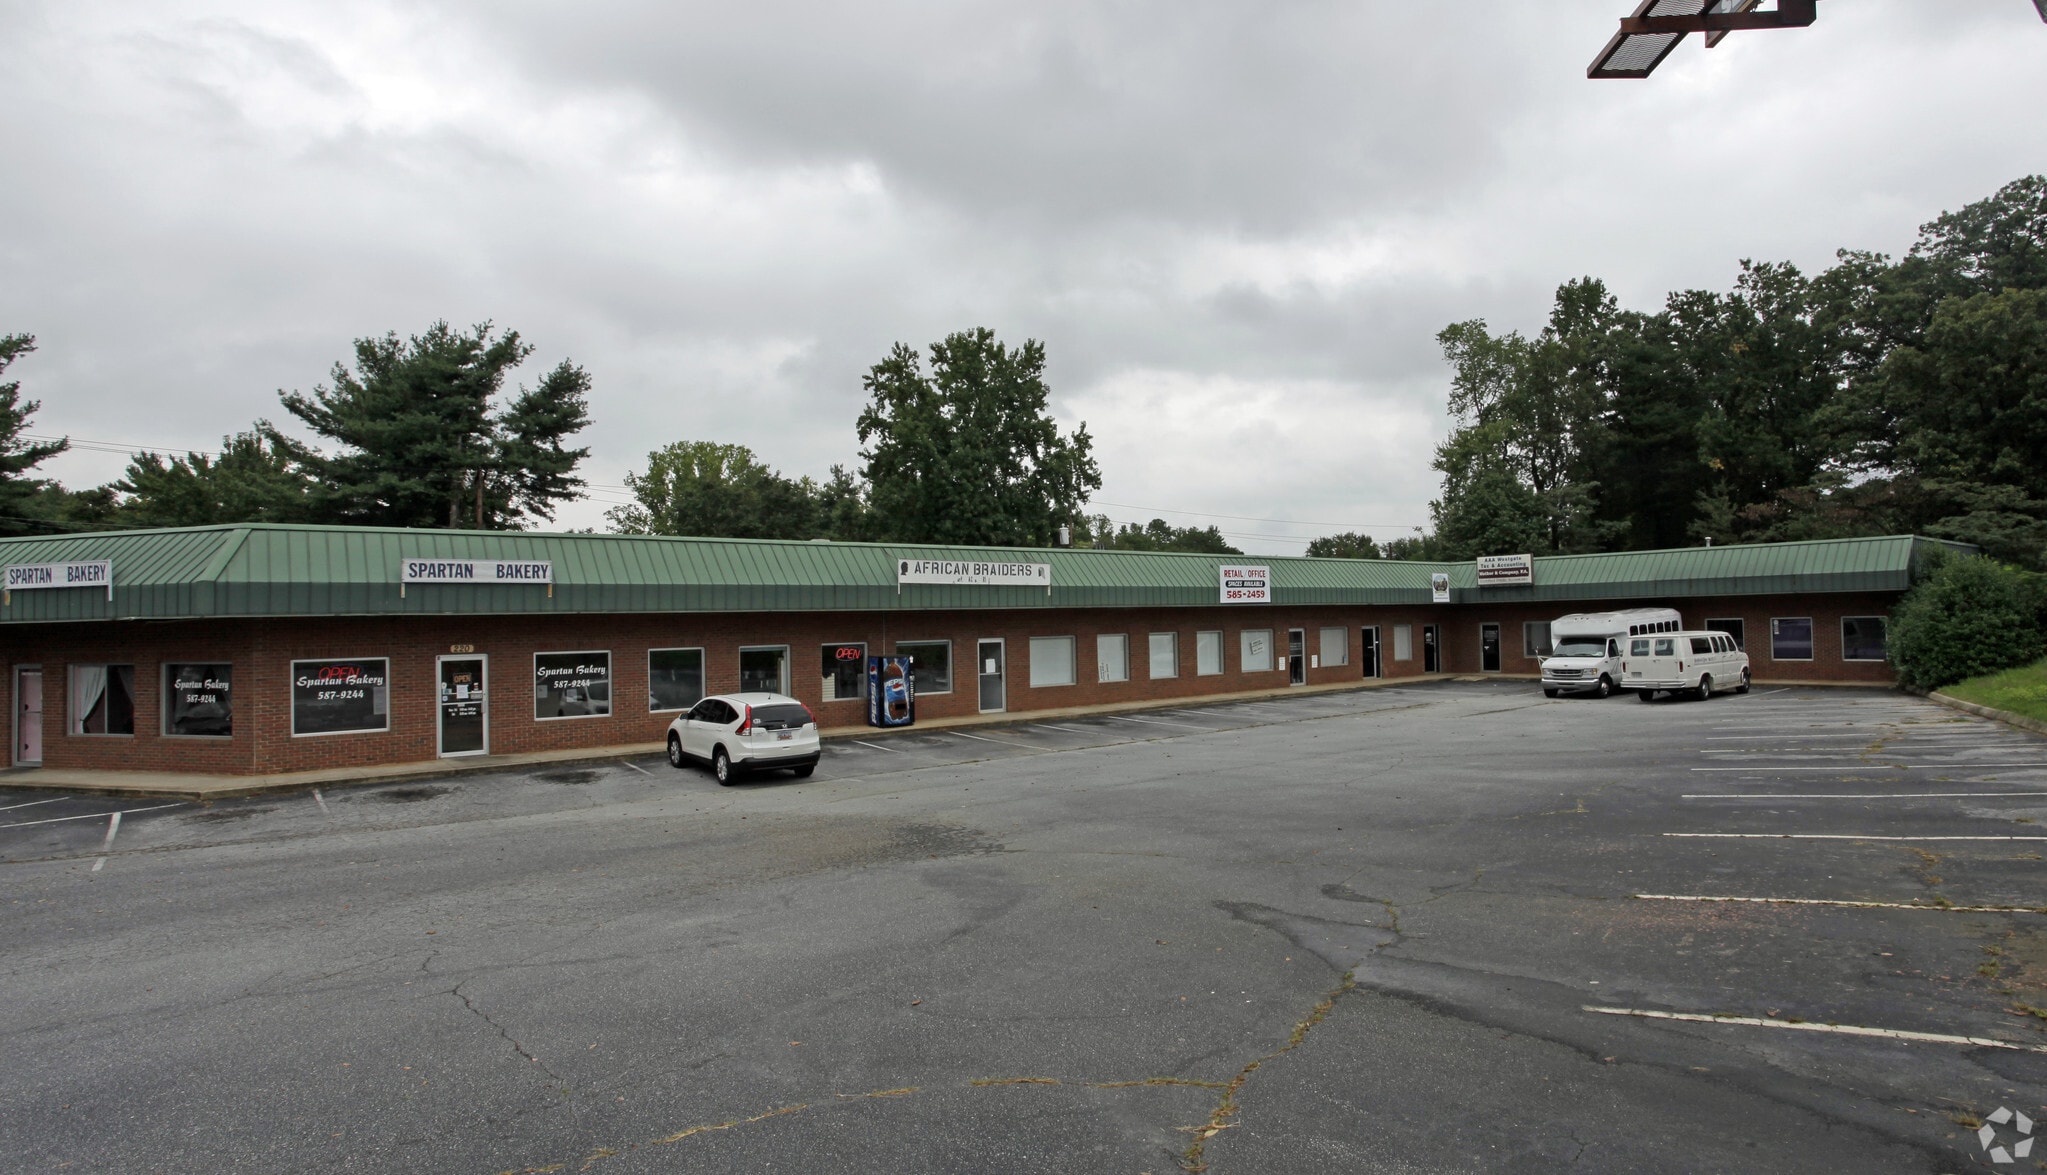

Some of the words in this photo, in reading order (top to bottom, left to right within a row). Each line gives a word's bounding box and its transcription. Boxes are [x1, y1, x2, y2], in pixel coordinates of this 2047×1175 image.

[9, 567, 53, 584] SPARTAN
[67, 564, 106, 582] BAKERY
[408, 562, 473, 578] SPARTAN
[496, 563, 549, 579] BAKERY
[914, 561, 970, 576] AFRICAN
[973, 563, 1032, 576] BRAIDERS
[1223, 569, 1243, 578] RETAIL
[1248, 569, 1266, 578] OFFICE
[1226, 590, 1265, 599] 585-2459
[836, 647, 860, 659] OPEN
[319, 667, 360, 681] OPEN
[537, 666, 573, 677] Spartan
[576, 664, 606, 675] Bakery
[174, 678, 202, 691] Spartan
[204, 678, 229, 691] Bakery
[296, 676, 342, 689] Spartan
[345, 674, 384, 686] Bakery
[553, 679, 591, 689] 587-9244
[186, 694, 216, 703] 587-9244
[317, 689, 364, 700] 587-9244
